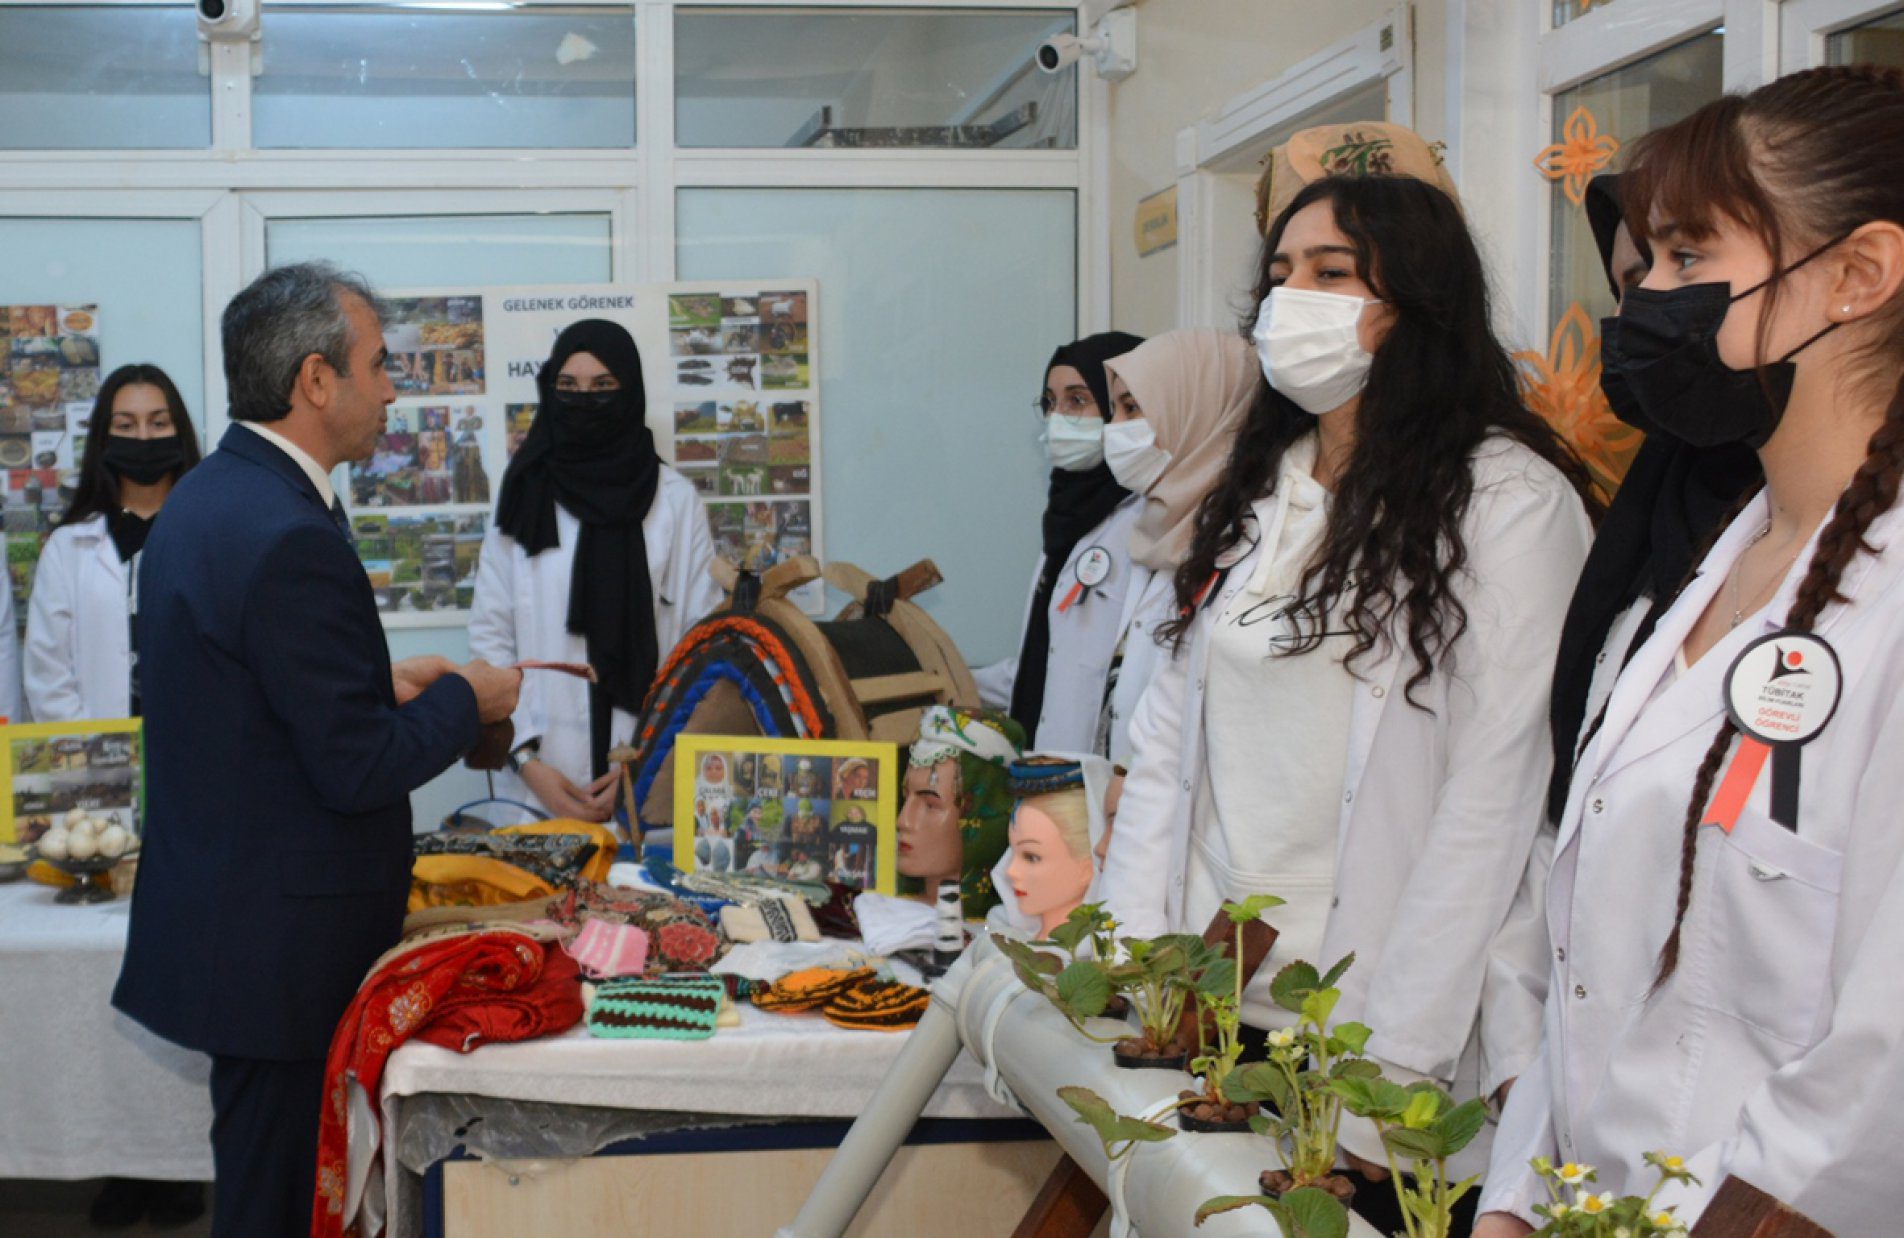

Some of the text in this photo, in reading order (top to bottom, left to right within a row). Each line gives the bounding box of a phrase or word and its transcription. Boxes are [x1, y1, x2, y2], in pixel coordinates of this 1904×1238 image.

[503, 295, 633, 312] GELENEK GÖRENEK
[1763, 686, 1804, 698] TÜBİTAK
